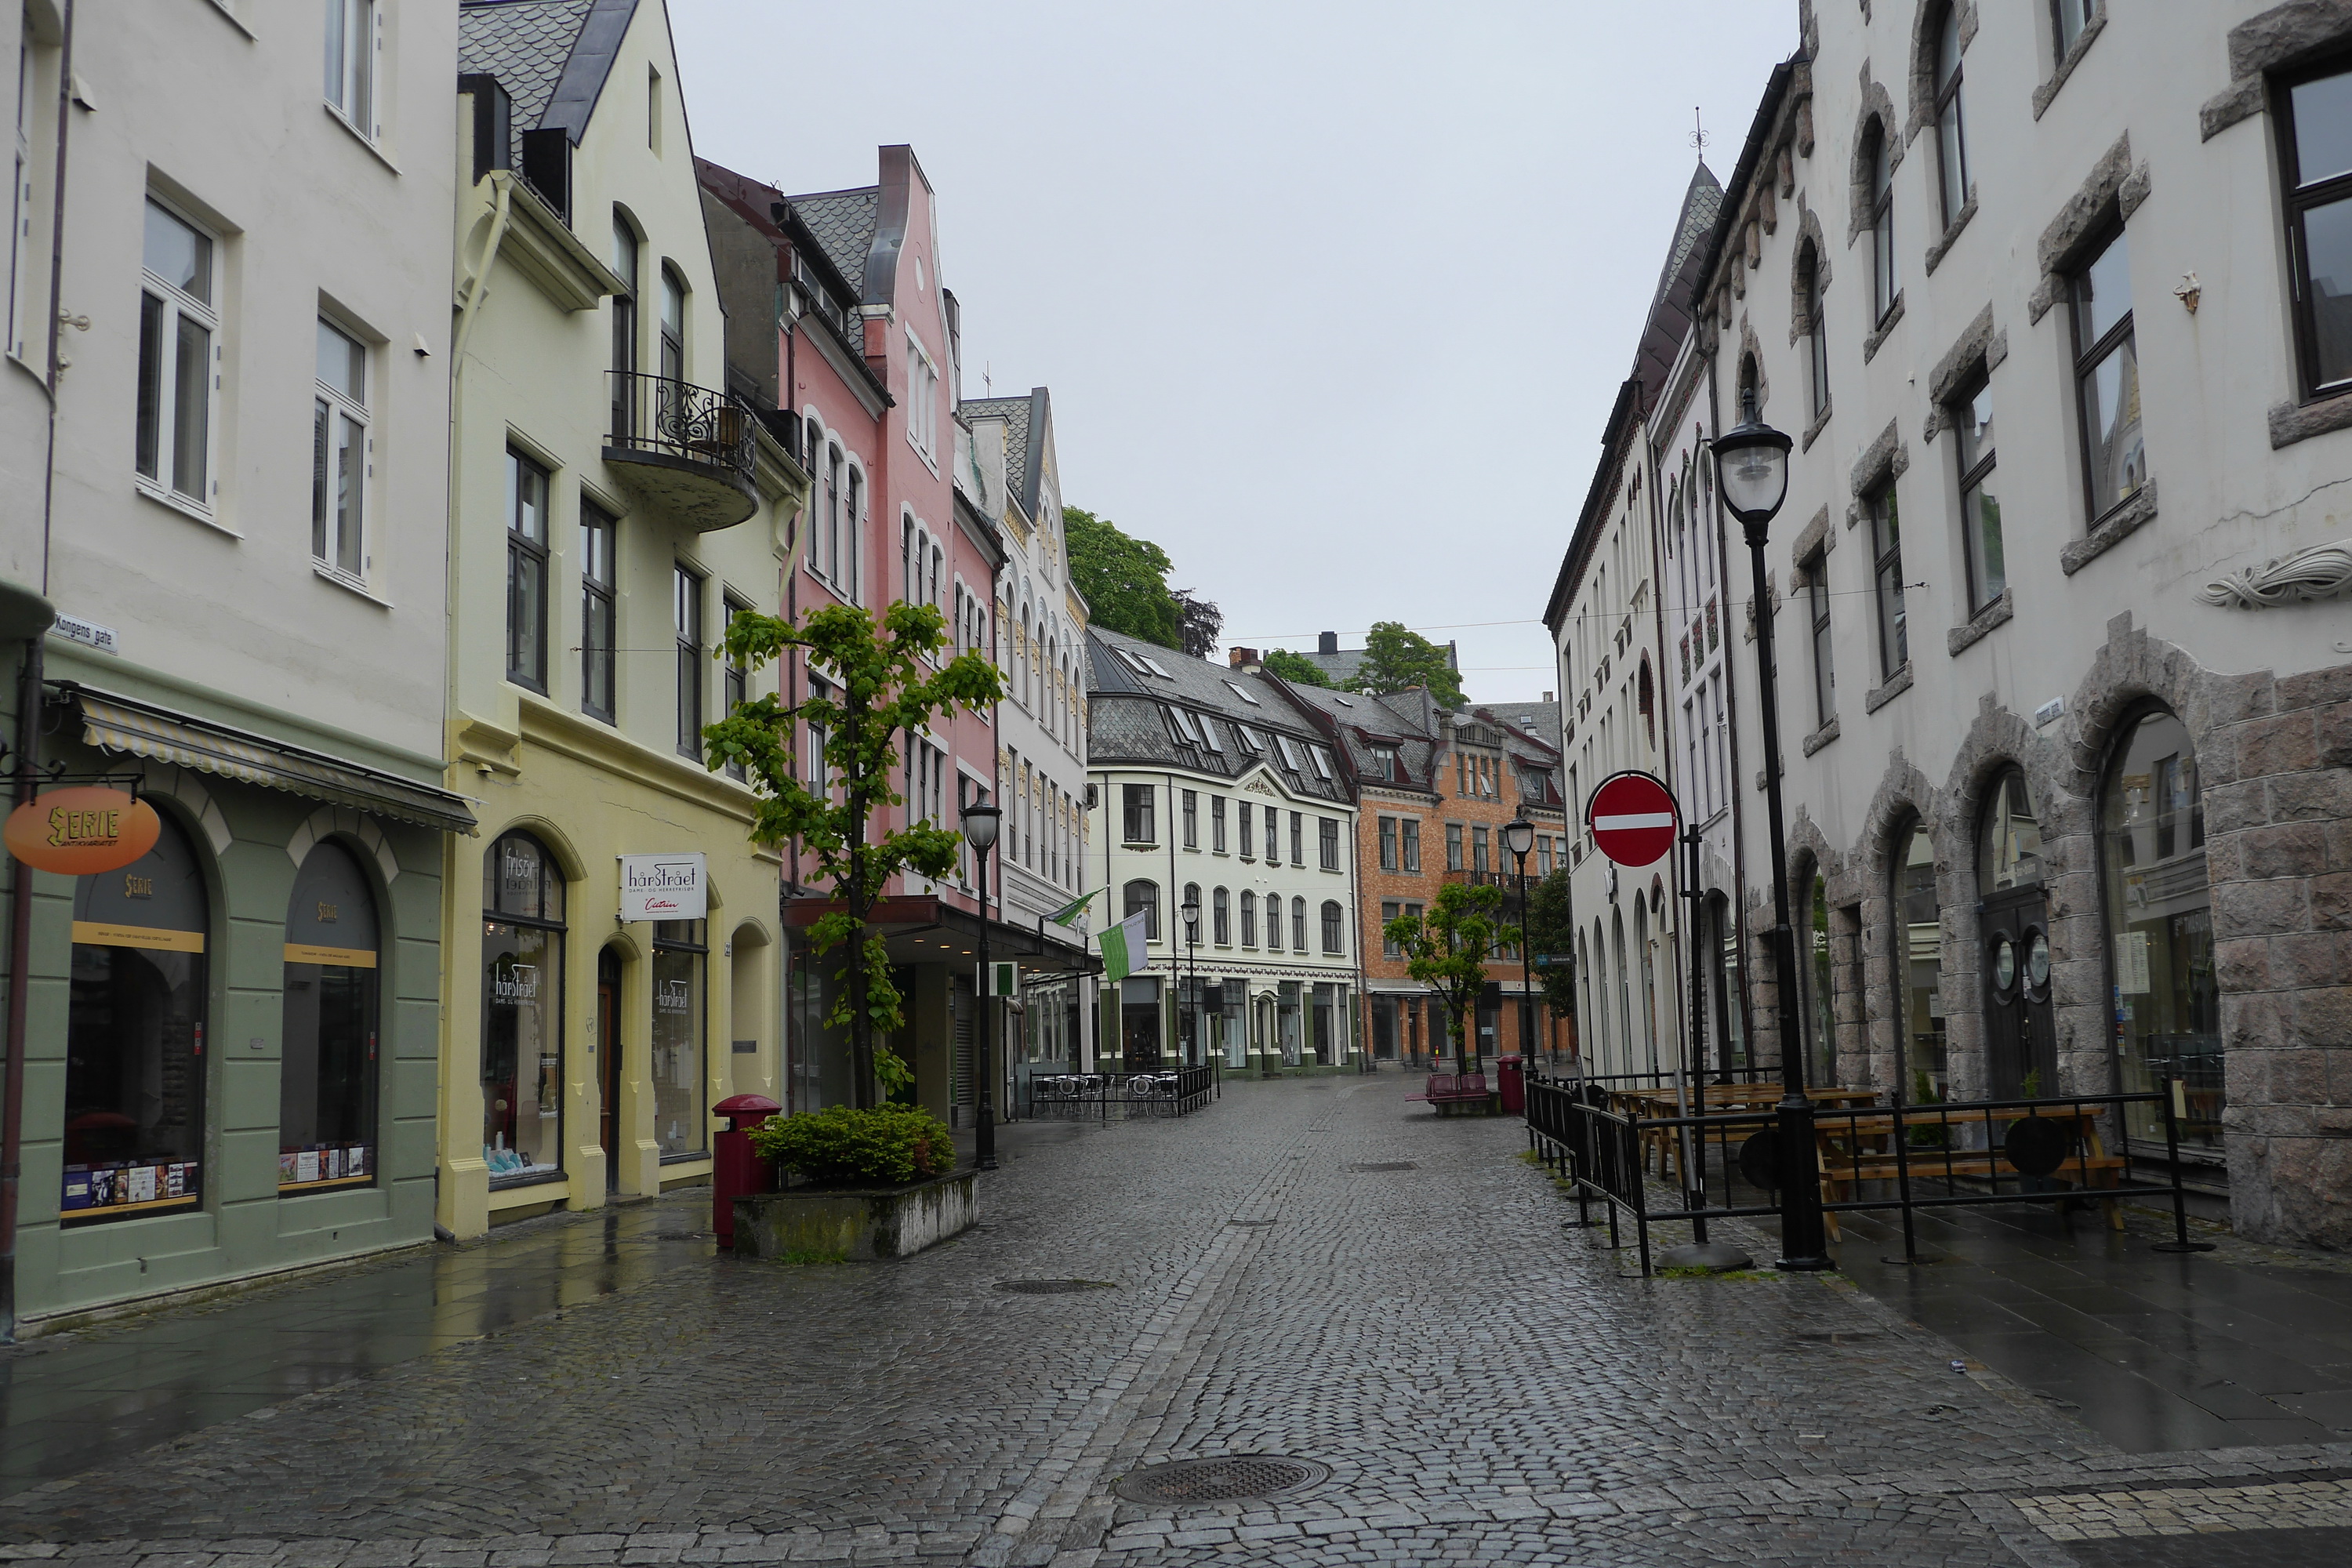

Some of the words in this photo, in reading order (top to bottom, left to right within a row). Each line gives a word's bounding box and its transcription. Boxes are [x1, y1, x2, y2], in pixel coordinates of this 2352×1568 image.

[55, 614, 90, 638] Kongens
[94, 630, 111, 645] gate
[47, 806, 119, 847] SERIE
